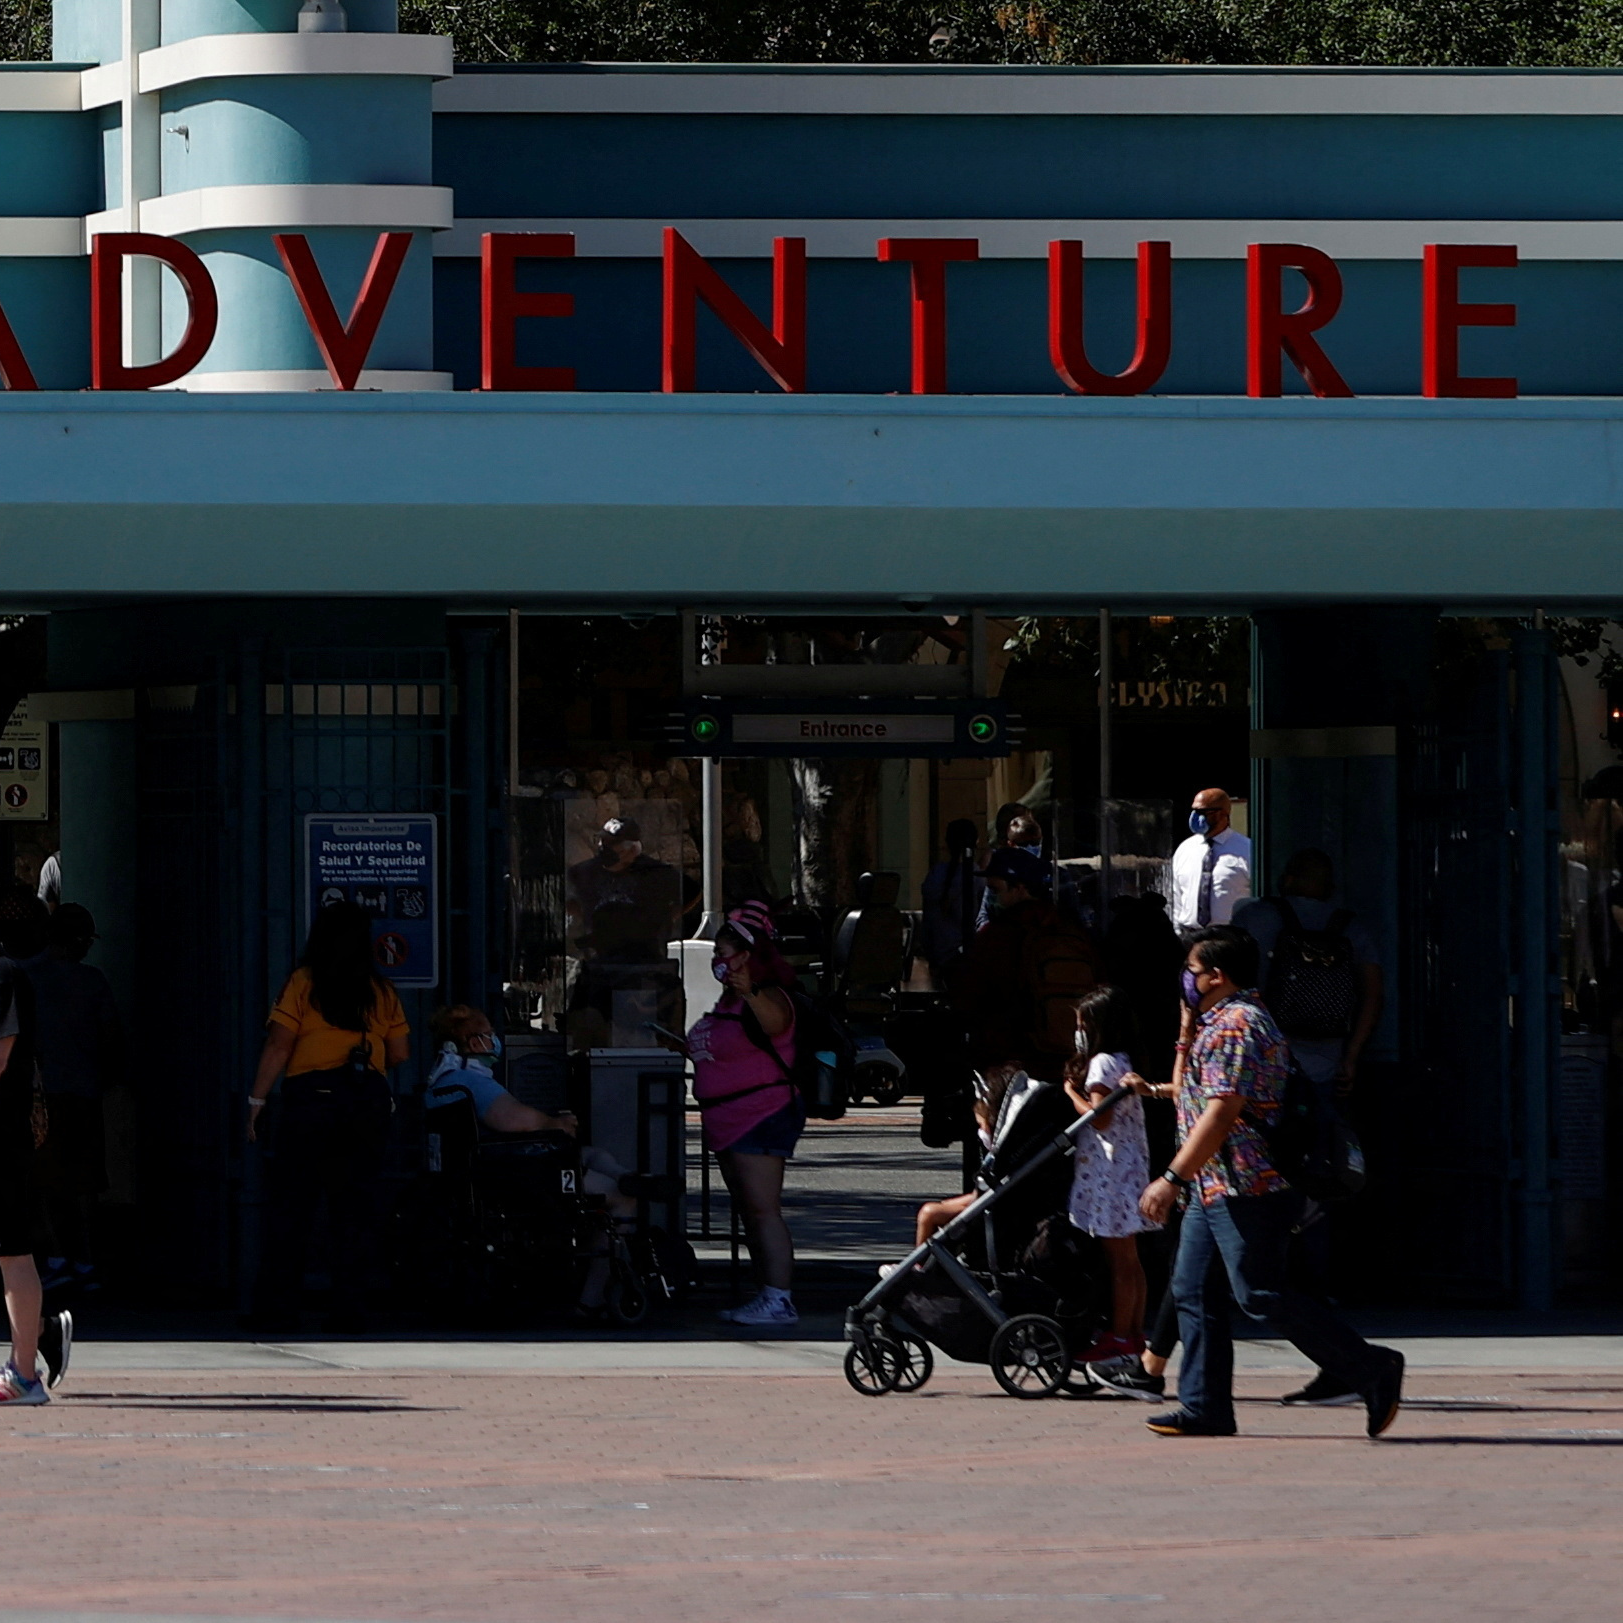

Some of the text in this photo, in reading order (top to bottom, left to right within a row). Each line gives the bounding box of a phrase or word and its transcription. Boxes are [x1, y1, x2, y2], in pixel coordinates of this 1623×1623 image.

[800, 720, 887, 736] Entrance
[322, 840, 422, 852] Recordatorios De
[318, 855, 426, 868] Salud Y Seguridad
[563, 1171, 574, 1192] 2
